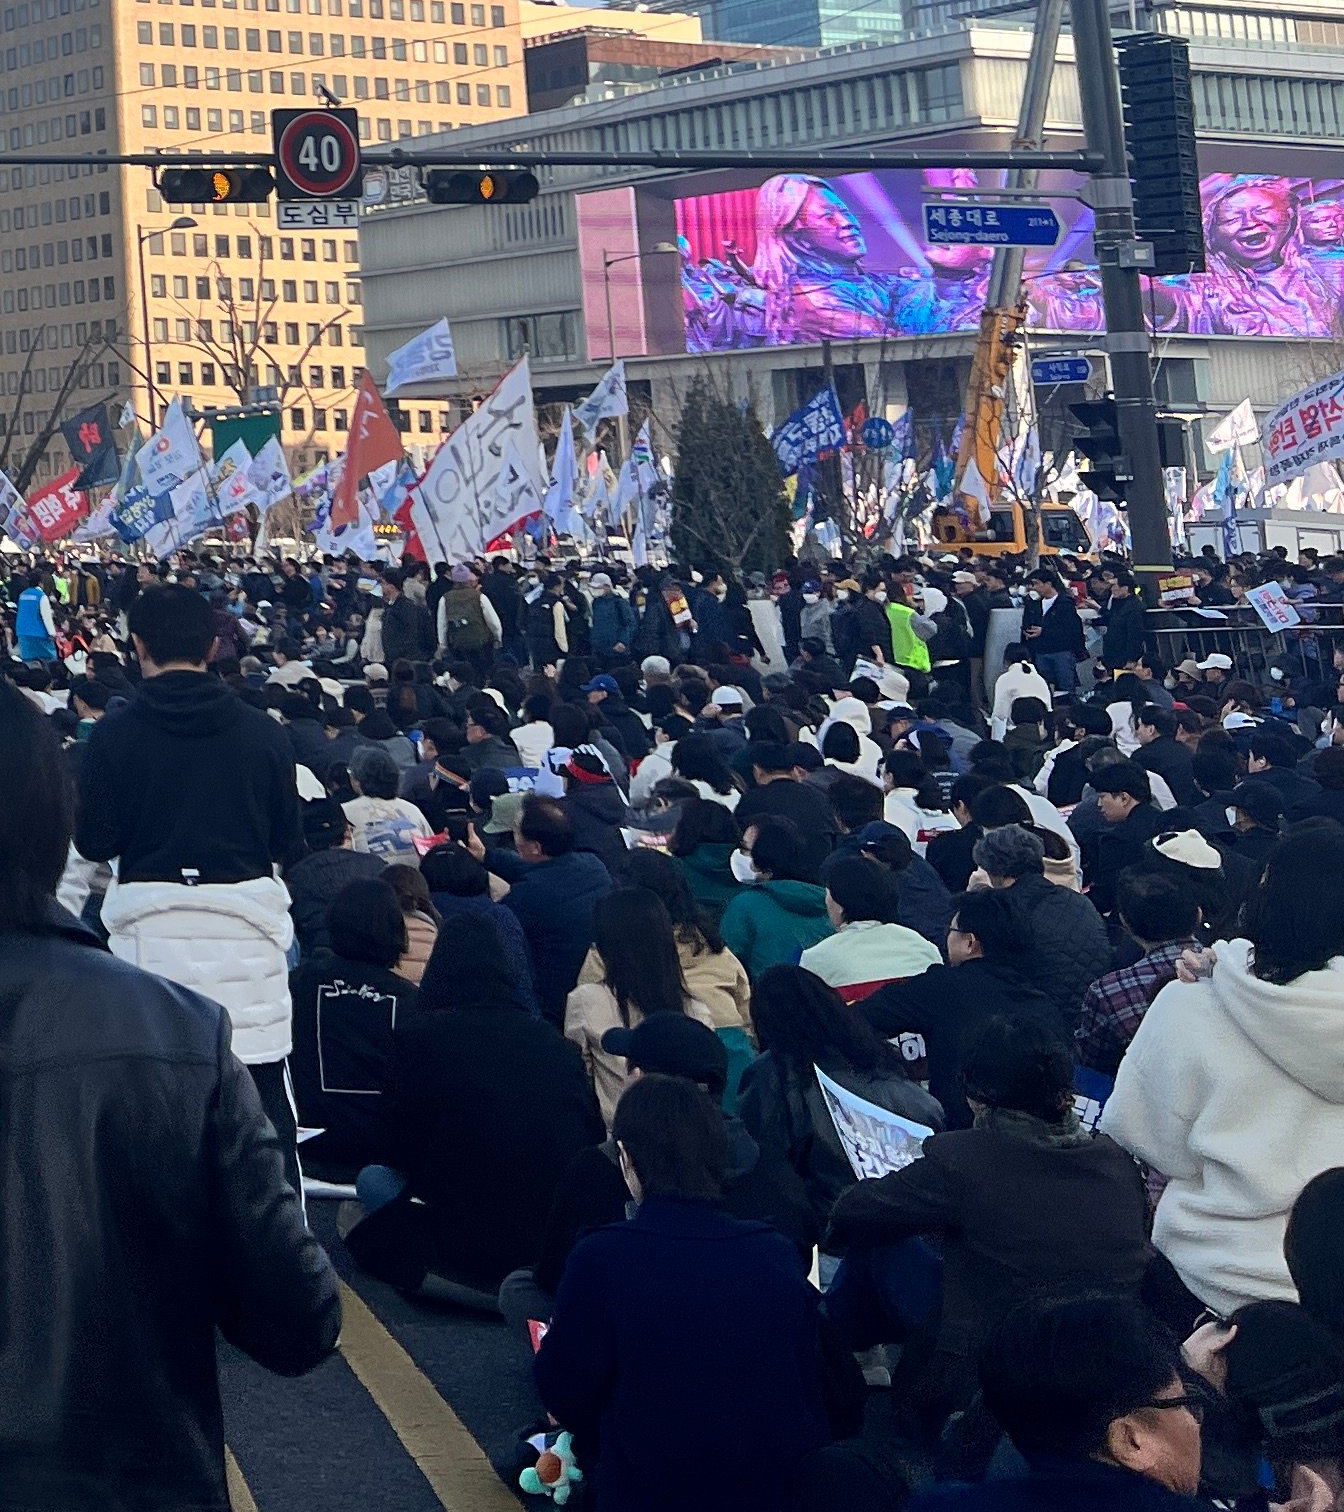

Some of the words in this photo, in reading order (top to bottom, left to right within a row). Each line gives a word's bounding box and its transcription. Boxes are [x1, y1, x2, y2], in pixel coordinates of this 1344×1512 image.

[298, 135, 340, 172] 40
[281, 203, 356, 225] 도심부
[929, 207, 1000, 227] 세종대로
[930, 228, 1009, 243] Sejong-daero
